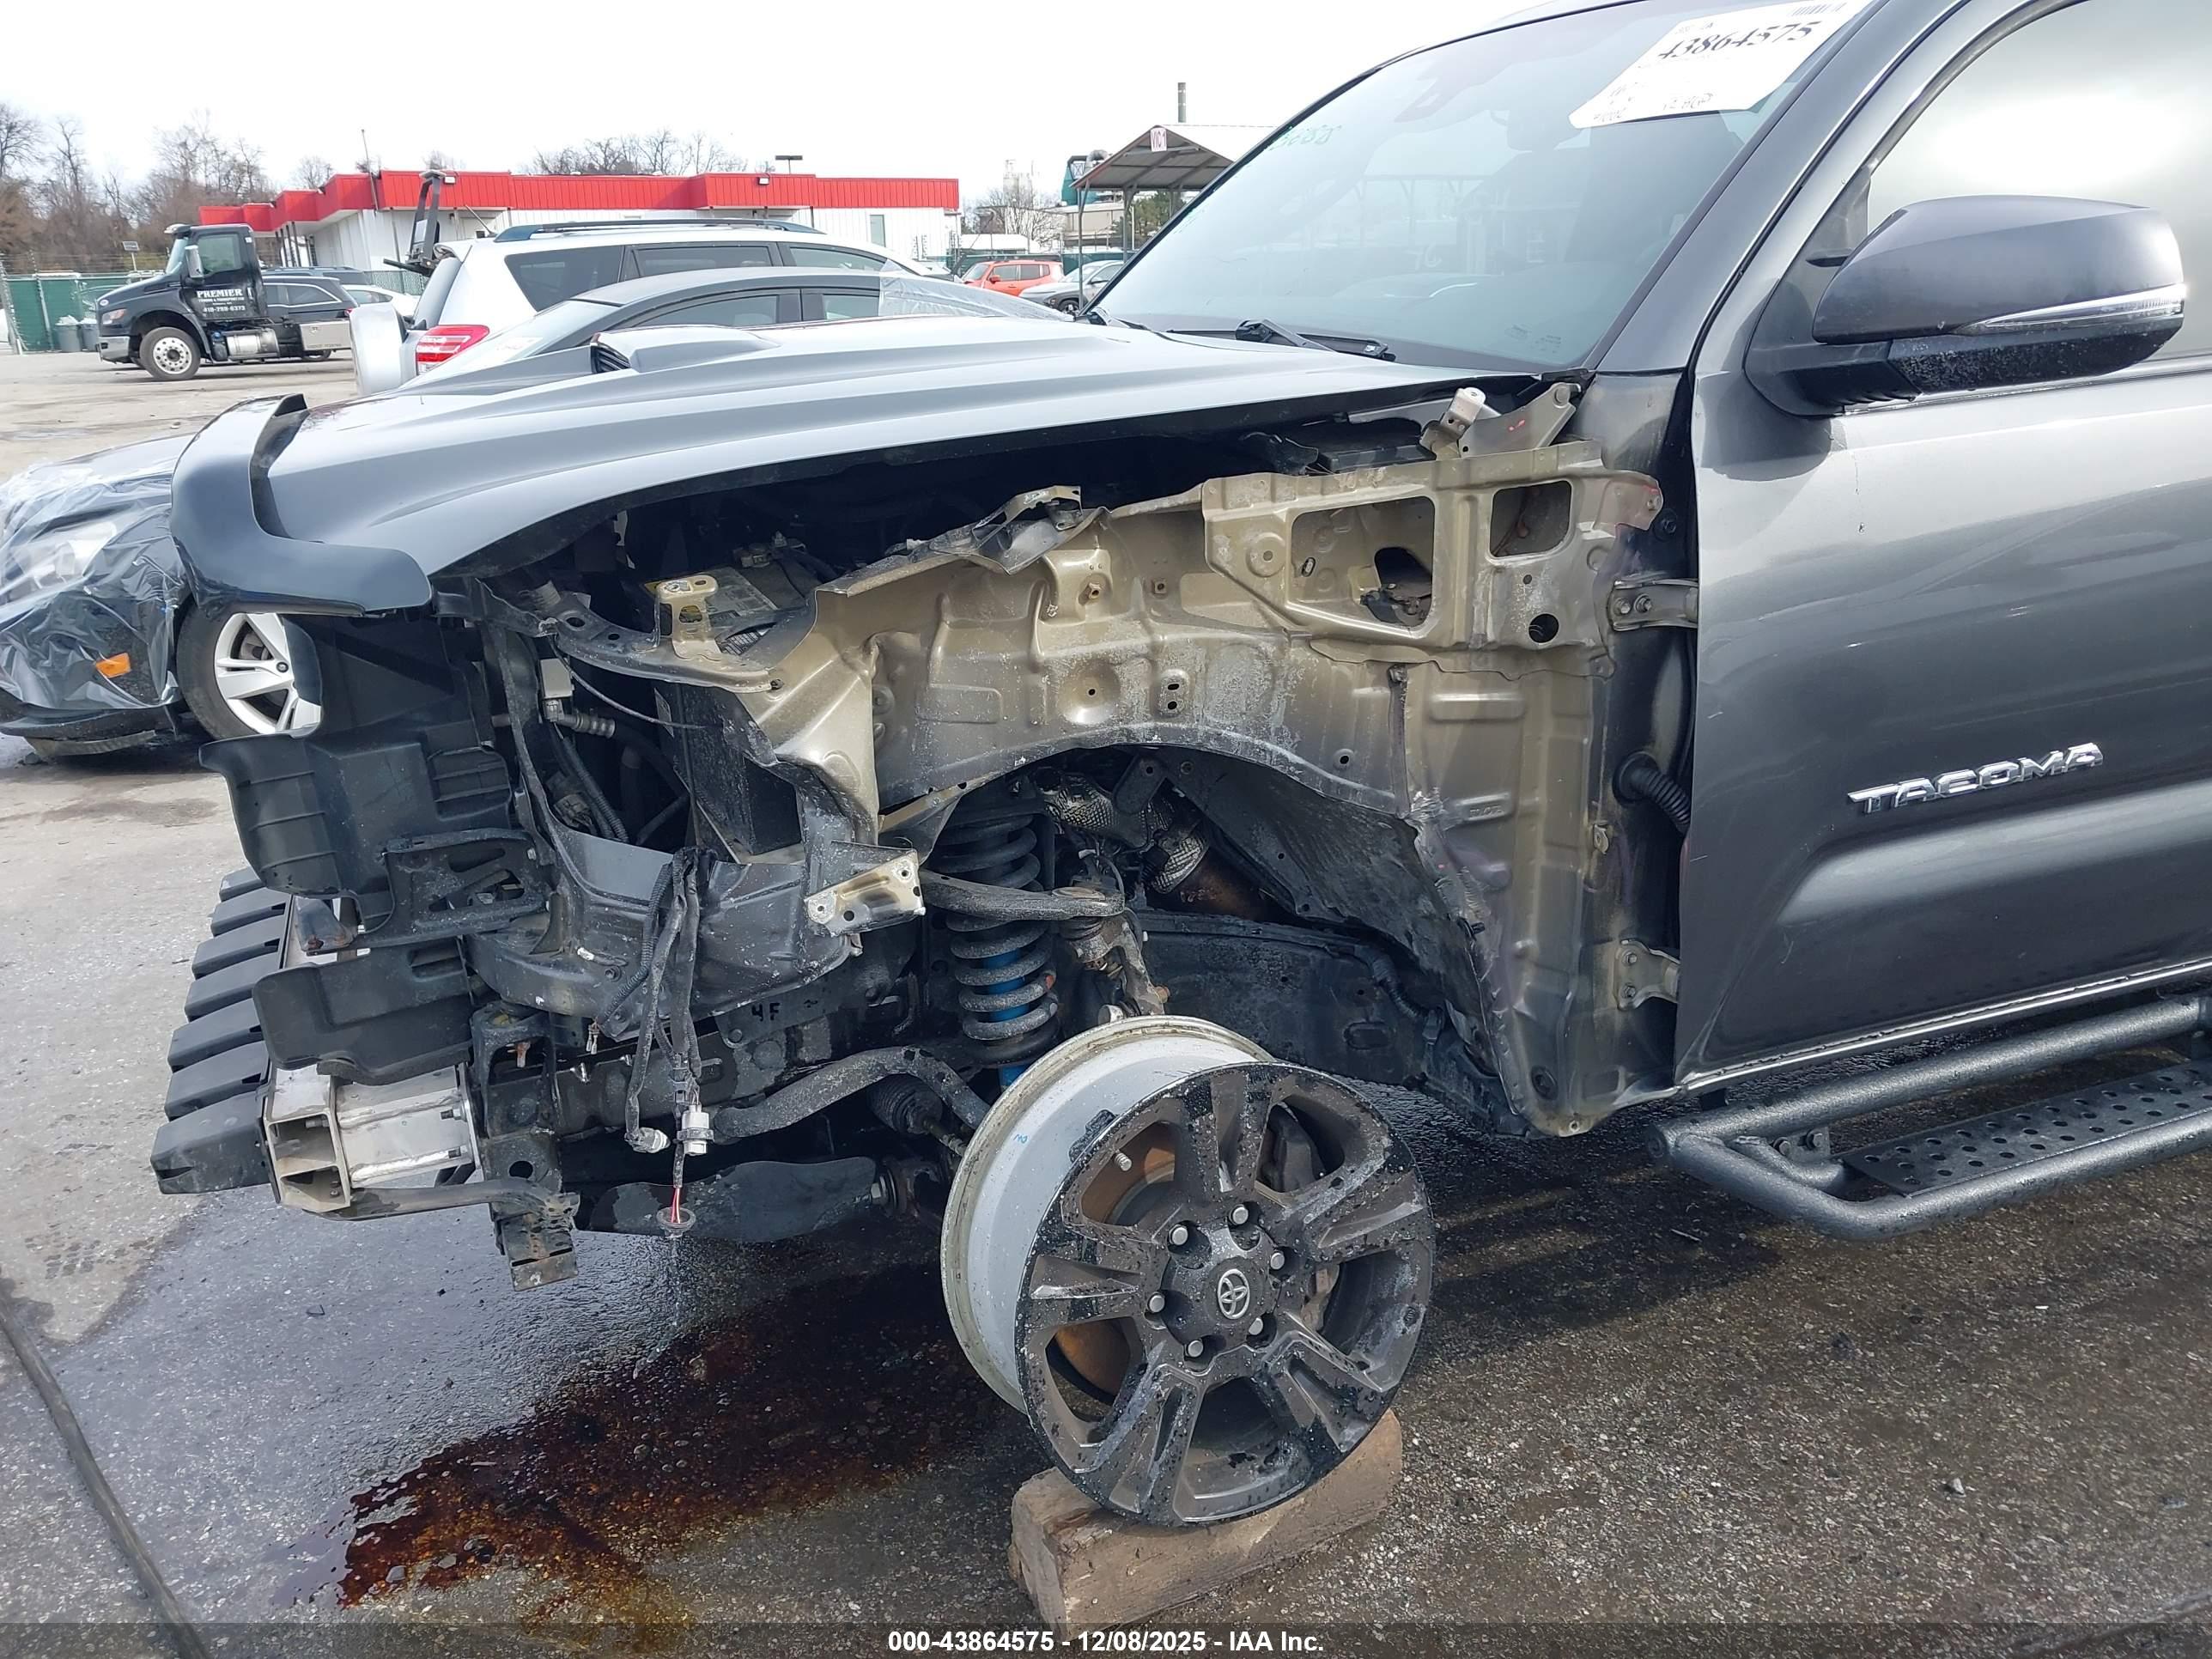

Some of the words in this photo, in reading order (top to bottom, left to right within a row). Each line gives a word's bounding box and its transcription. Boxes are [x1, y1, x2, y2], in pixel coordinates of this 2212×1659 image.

[1657, 20, 1822, 60] 43864575
[197, 289, 243, 298] PREMIER
[1847, 742, 2103, 815] TACOMA
